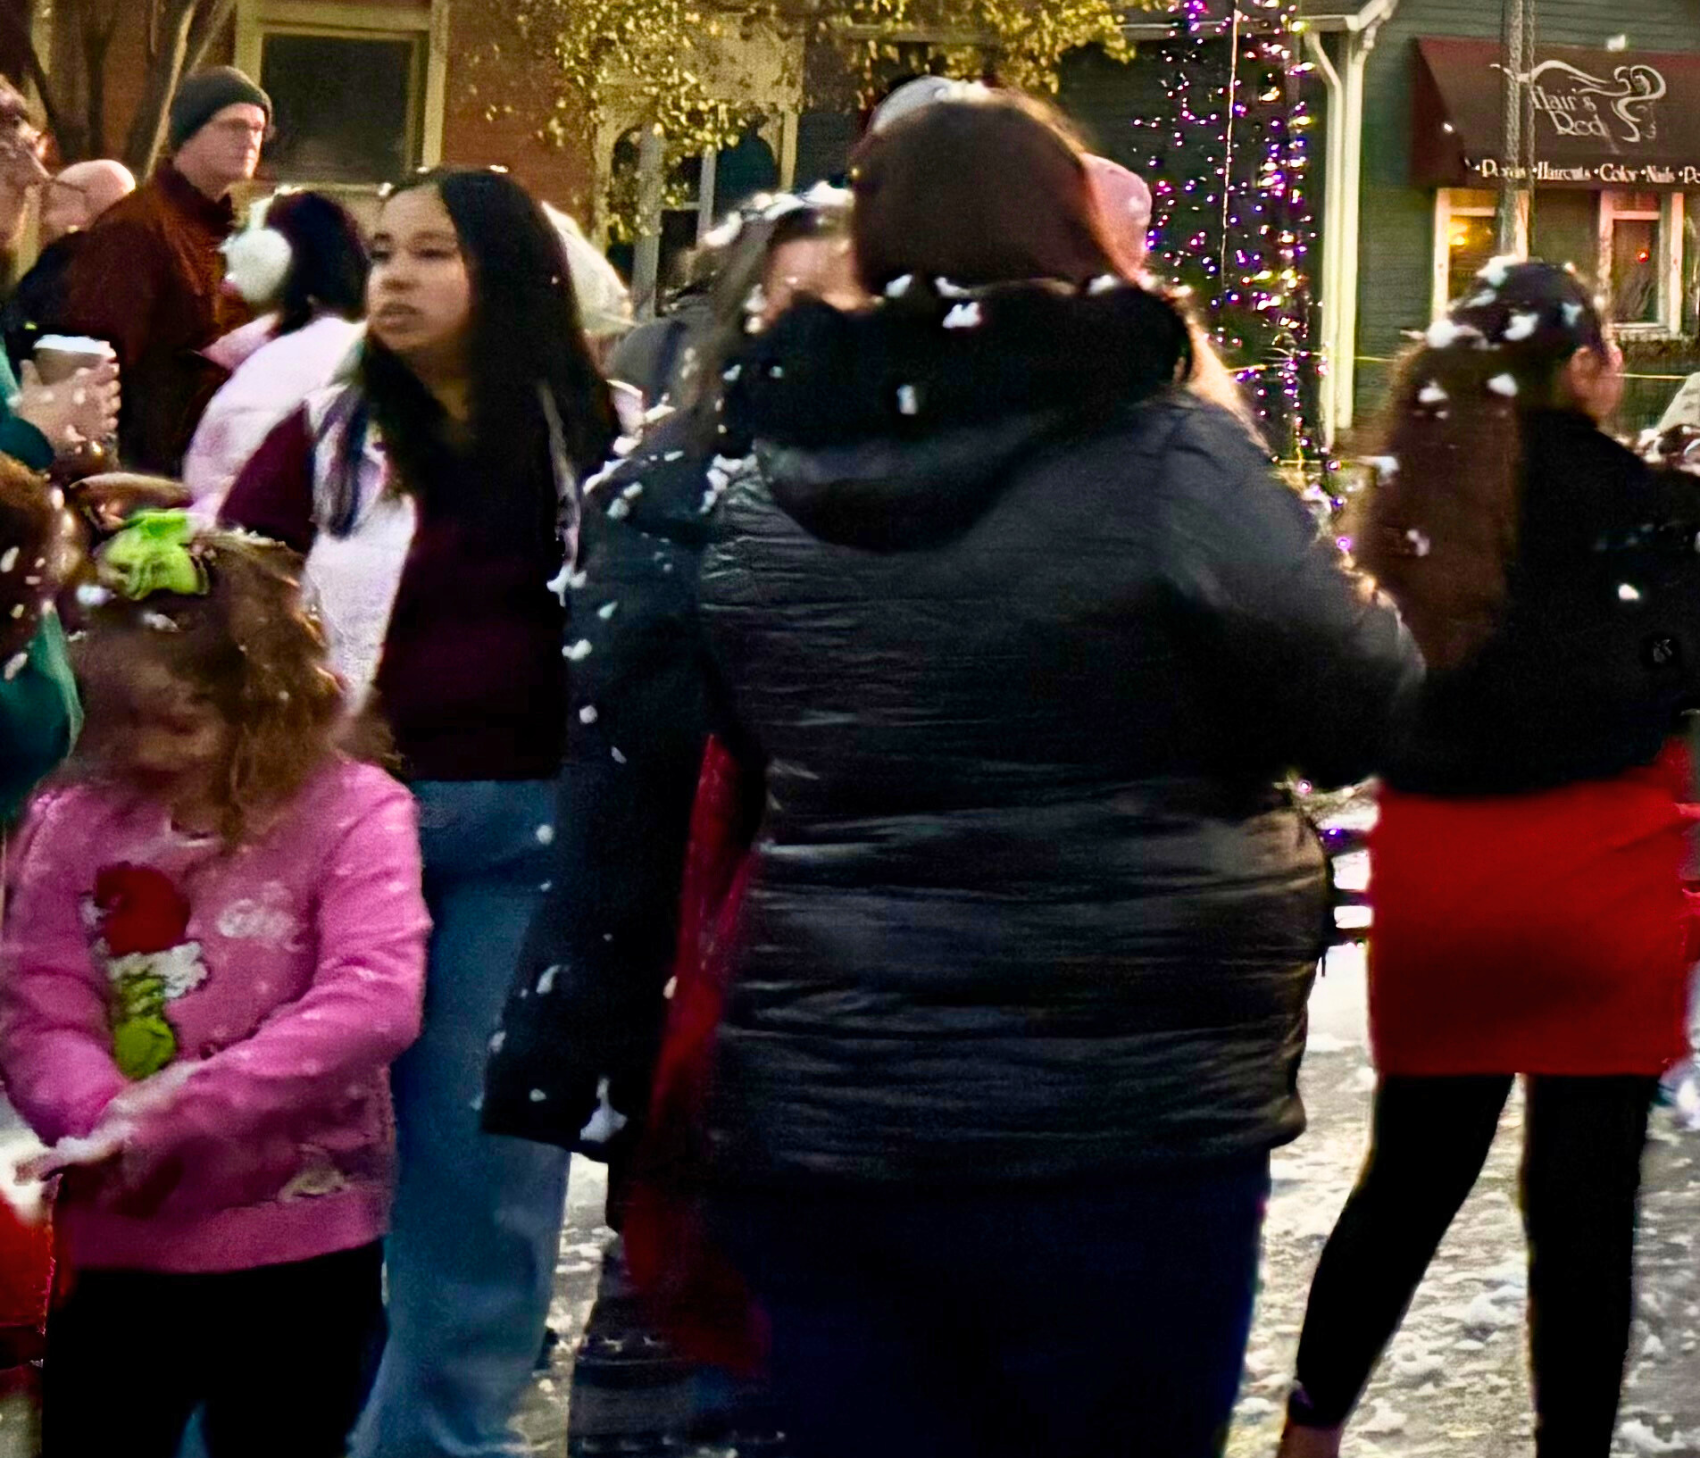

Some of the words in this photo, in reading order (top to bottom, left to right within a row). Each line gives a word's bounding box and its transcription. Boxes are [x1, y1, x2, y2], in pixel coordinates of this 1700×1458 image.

[1530, 85, 1598, 112] Hair's
[1481, 158, 1526, 180] Prms
[1599, 162, 1639, 183] Color
[1645, 164, 1676, 184] Nails
